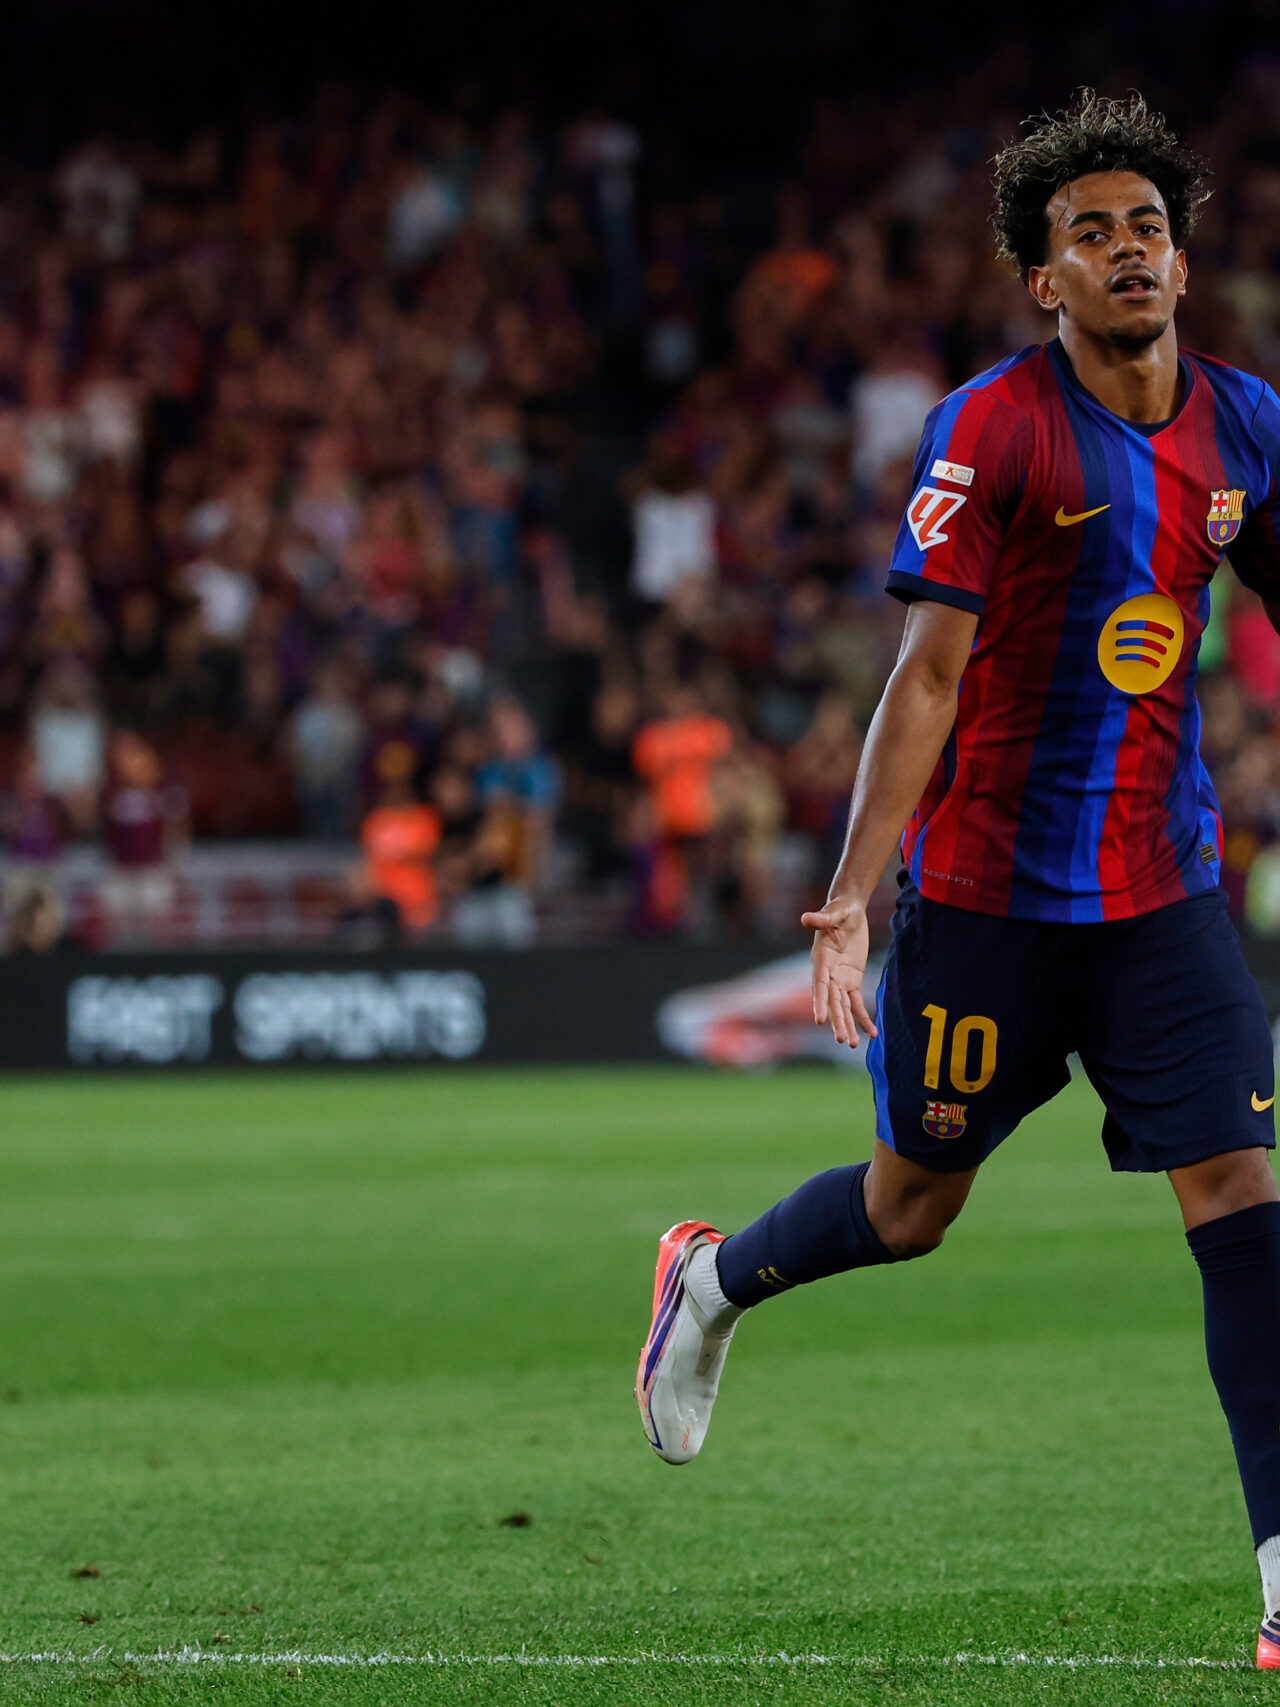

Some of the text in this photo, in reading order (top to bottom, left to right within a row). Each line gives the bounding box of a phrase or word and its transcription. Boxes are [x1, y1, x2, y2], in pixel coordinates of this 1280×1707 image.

[1218, 512, 1233, 520] FCB
[68, 975, 223, 1061] FAST
[921, 1003, 998, 1093] 10
